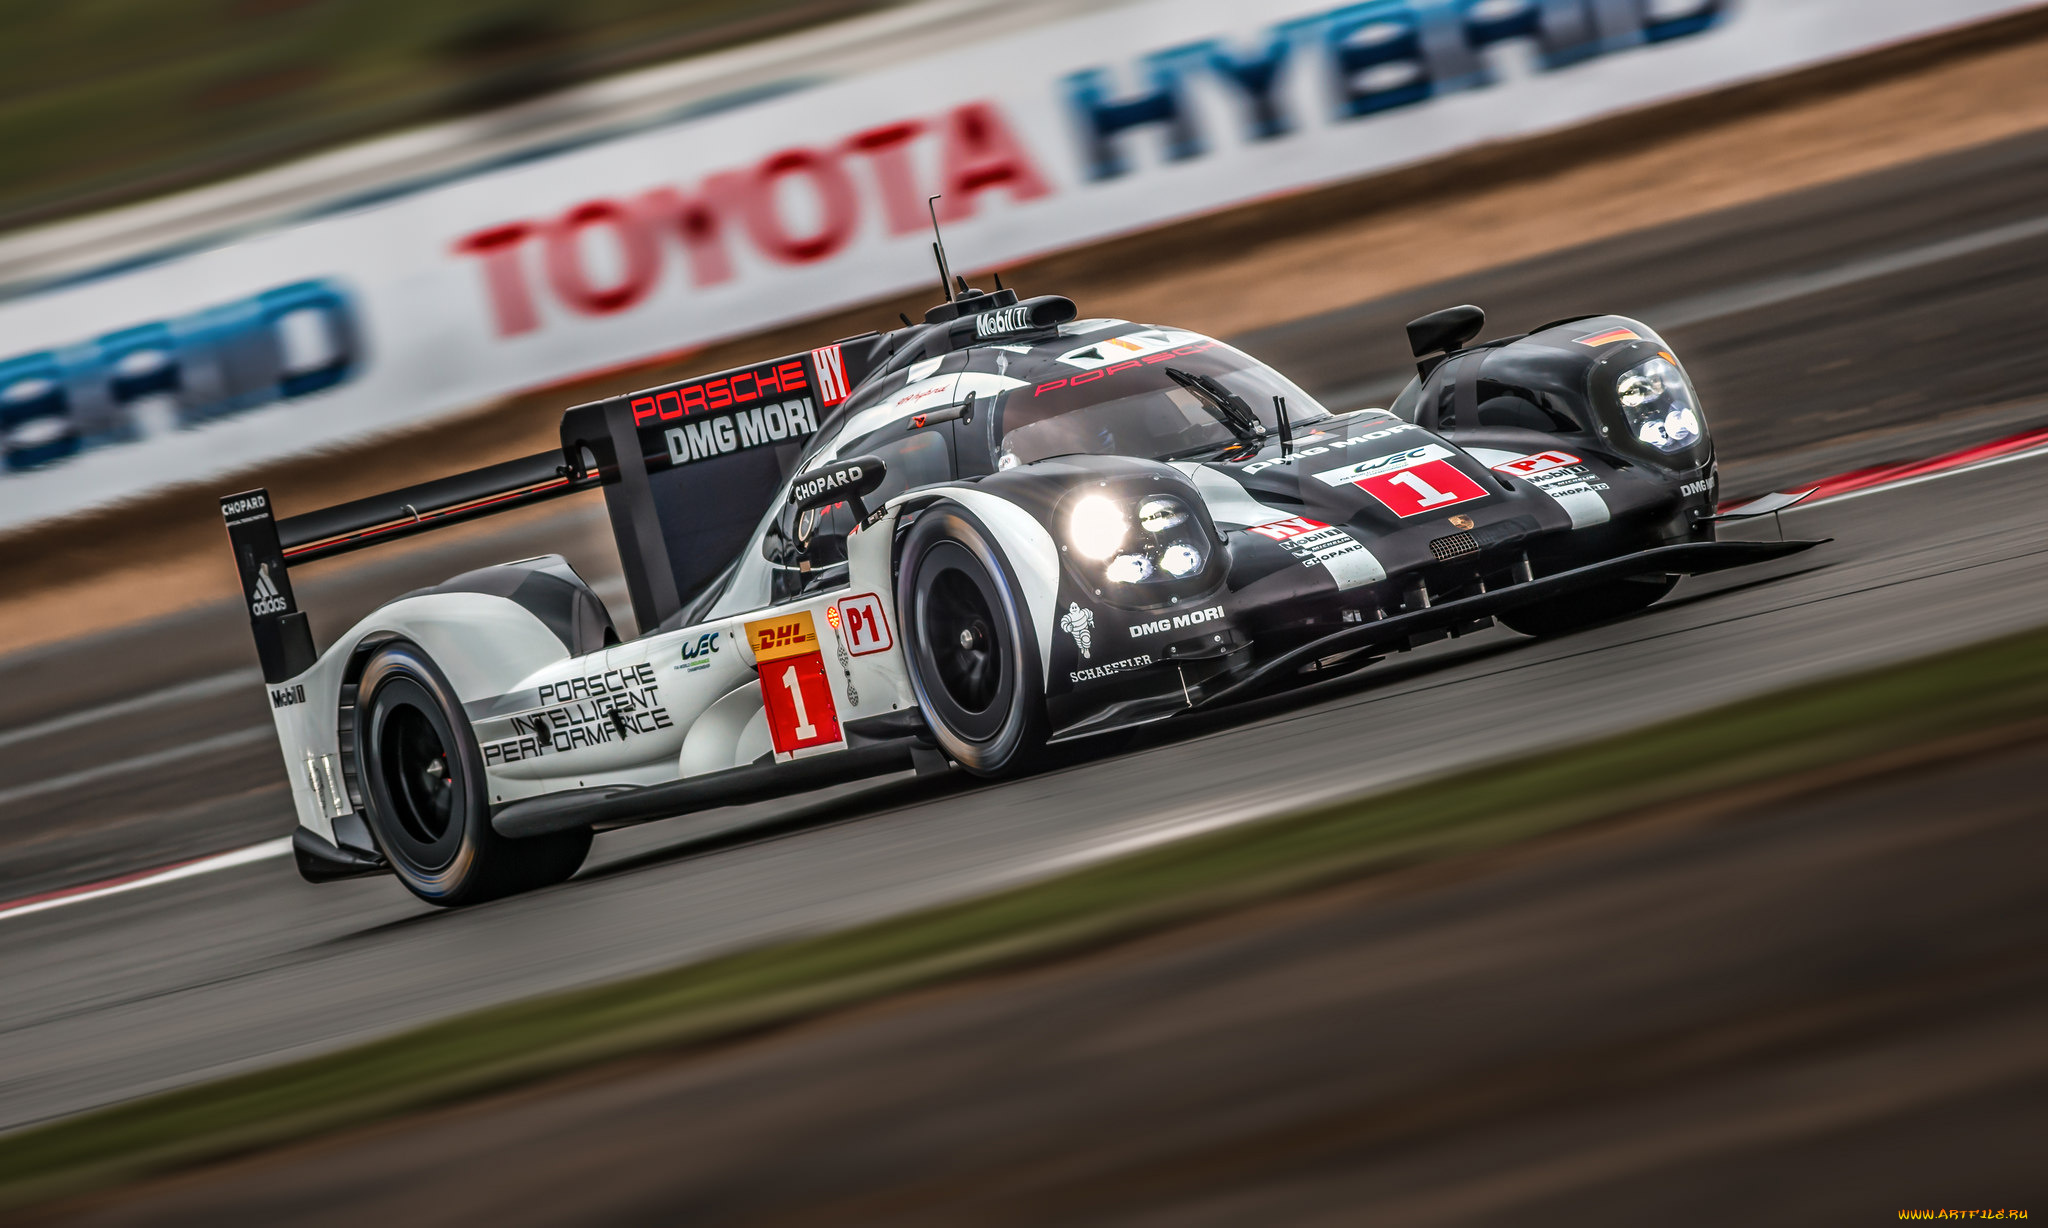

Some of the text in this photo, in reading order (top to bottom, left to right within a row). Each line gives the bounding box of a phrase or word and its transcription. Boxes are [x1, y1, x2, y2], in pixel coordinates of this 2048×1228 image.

[448, 98, 1052, 340] TOYOTA
[976, 308, 1014, 337] Mobil
[812, 345, 847, 402] HY
[631, 361, 807, 428] PORSCHE
[664, 397, 819, 466] DMG MORI
[1354, 448, 1426, 473] WEC
[1507, 454, 1566, 471] P1
[795, 466, 863, 501] CHOPARD
[1526, 467, 1572, 483] Mobil
[1557, 475, 1597, 486] MICHELIN
[1388, 470, 1458, 507] 1
[1551, 483, 1608, 498] CHOPARD
[1680, 480, 1706, 497] DMG
[221, 495, 266, 516] CHOPARD
[1252, 517, 1320, 540] HY
[1281, 532, 1327, 550] Mobil
[1304, 544, 1362, 567] CHOPARD
[1311, 537, 1352, 552] MICHELIN
[252, 596, 287, 616] adidas
[846, 605, 880, 646] P1
[1129, 606, 1225, 638] DMG MORI
[681, 632, 720, 660] WEC
[758, 623, 806, 650] DHL
[271, 686, 297, 708] Mobil
[538, 662, 656, 706] PORSCHE
[782, 665, 817, 741] 1
